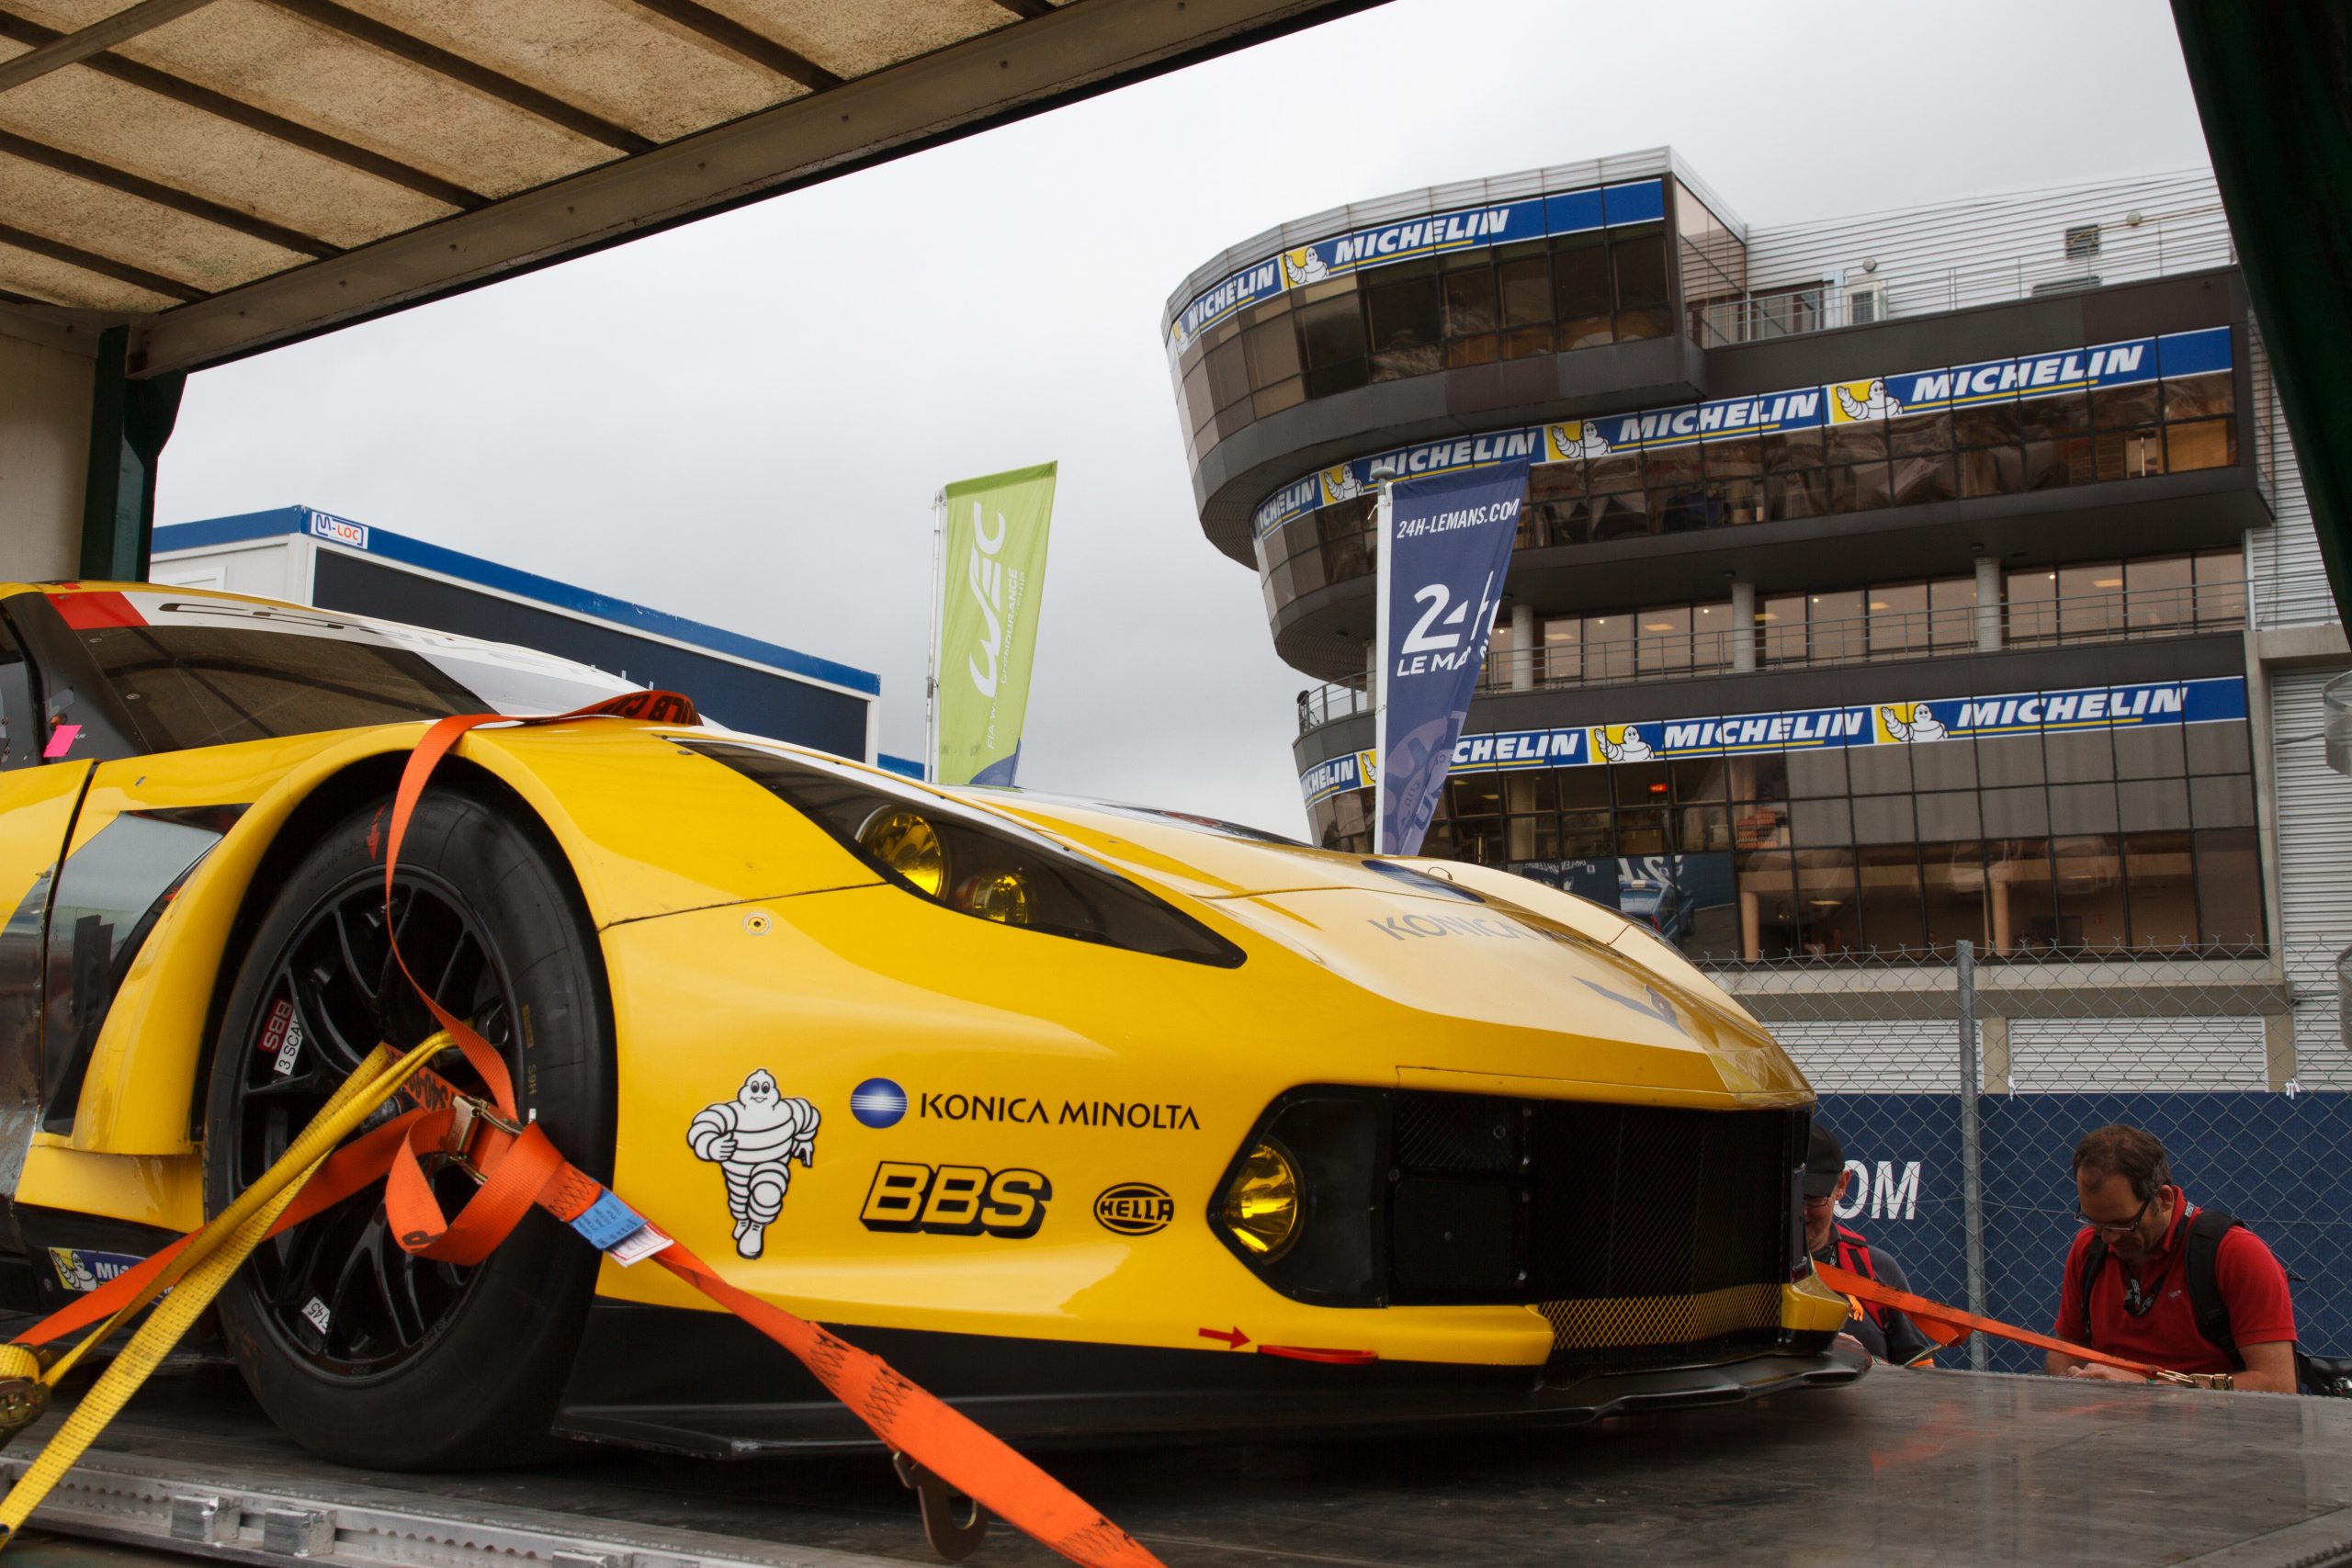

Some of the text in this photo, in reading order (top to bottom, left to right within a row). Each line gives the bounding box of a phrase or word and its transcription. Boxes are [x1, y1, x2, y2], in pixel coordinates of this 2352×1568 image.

[1335, 209, 1510, 262] MICHELIN
[1187, 263, 1274, 333] MICHELIN
[1912, 345, 2144, 402] MICHELIN
[1619, 392, 1819, 443] MICHELIN
[1369, 432, 1537, 481] MICHELIN
[316, 514, 358, 541] M-LOC
[969, 500, 1006, 698] WEC
[1396, 656, 1428, 677] LE
[1957, 687, 2188, 728] MICHELIN
[1452, 731, 1579, 763] CHELIN
[1663, 712, 1864, 750] MICHELIN
[1367, 914, 1541, 942] KONICA
[263, 1000, 293, 1051] BBS
[278, 1059, 291, 1070] 3
[920, 1092, 1201, 1130] KONICA MINOLTA
[859, 1161, 1053, 1240] BBS
[1099, 1199, 1175, 1223] HELLA
